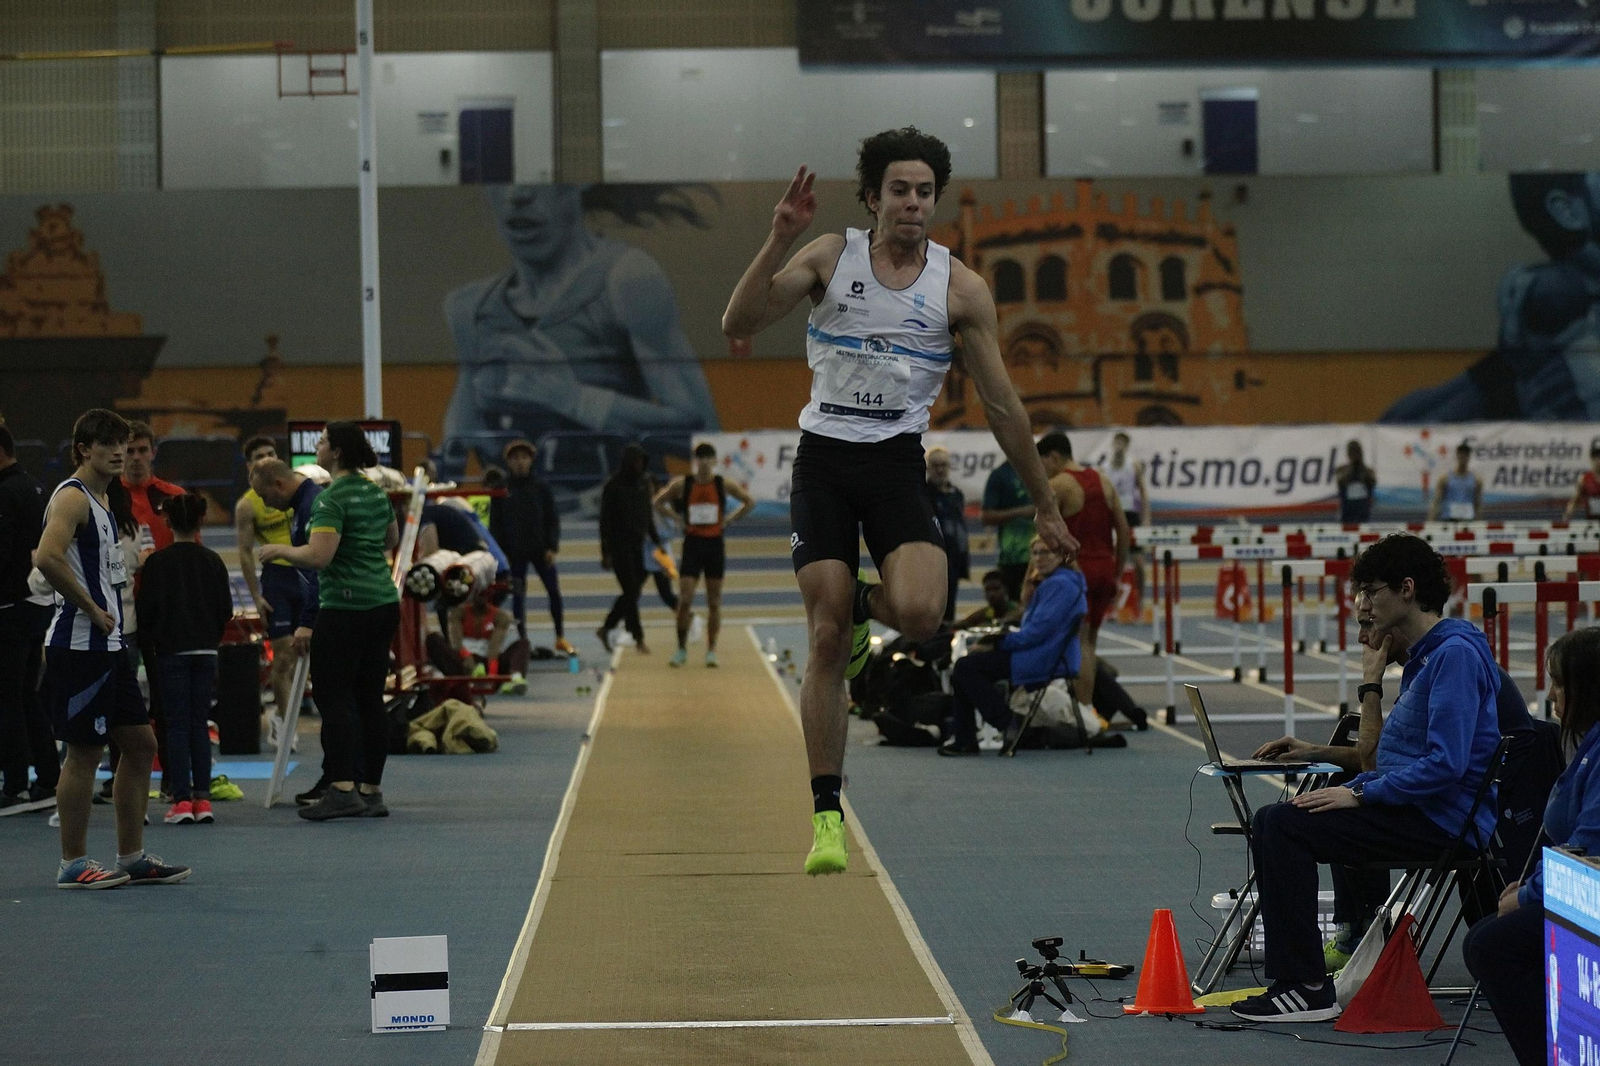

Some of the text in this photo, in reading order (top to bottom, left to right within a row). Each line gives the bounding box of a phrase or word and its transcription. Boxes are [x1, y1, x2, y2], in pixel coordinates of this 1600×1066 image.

[362, 160, 371, 172] 4
[853, 392, 884, 406] 144
[1149, 447, 1337, 494] tismo.gal
[391, 1015, 434, 1023] MONDO
